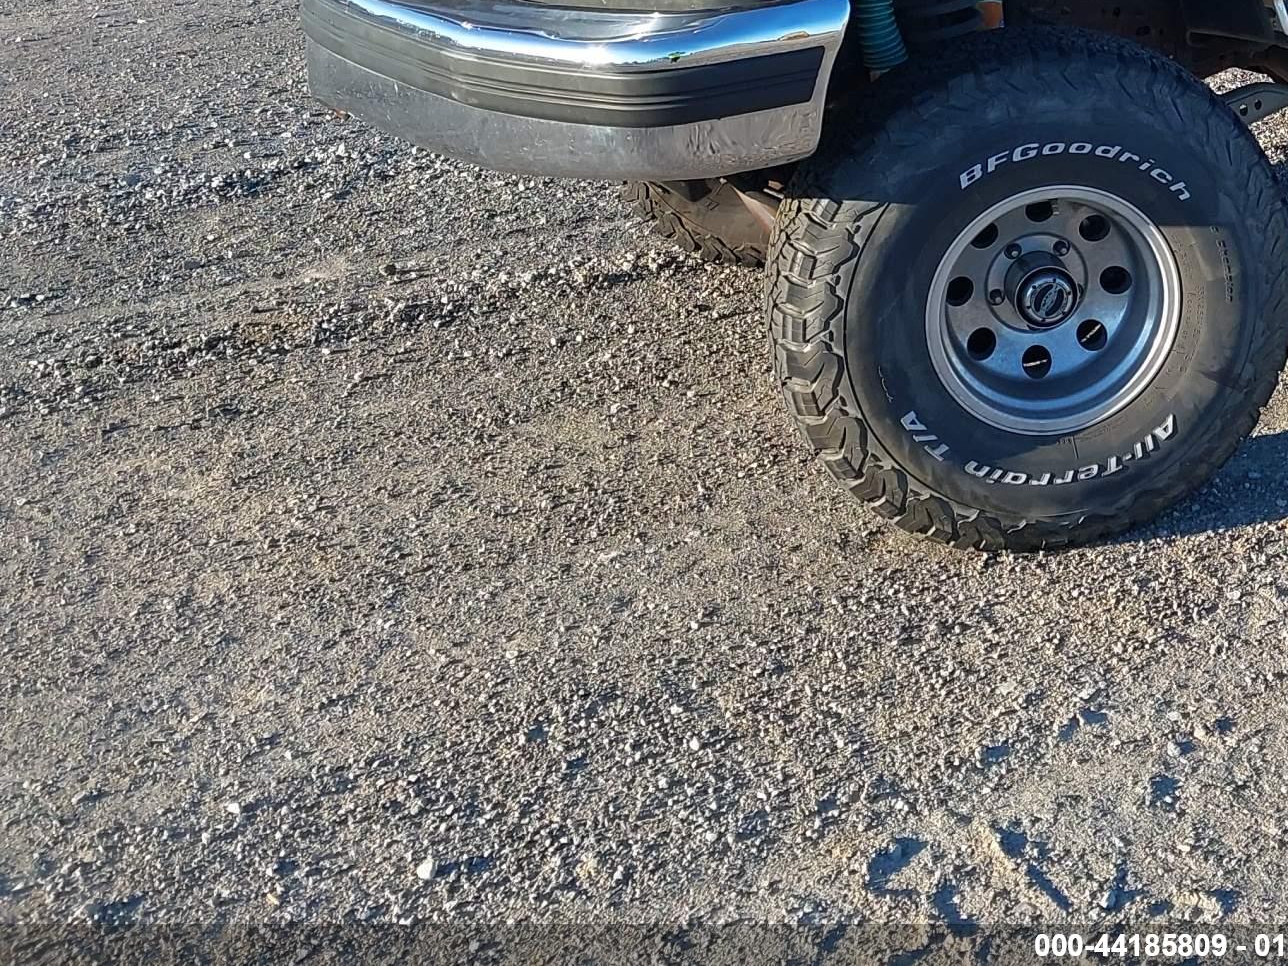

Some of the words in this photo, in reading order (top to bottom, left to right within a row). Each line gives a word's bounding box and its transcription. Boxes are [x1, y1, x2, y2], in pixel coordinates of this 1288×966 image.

[959, 141, 1191, 202] BFGoodrich
[900, 410, 950, 462] T/A
[964, 412, 1175, 486] All-Terrain
